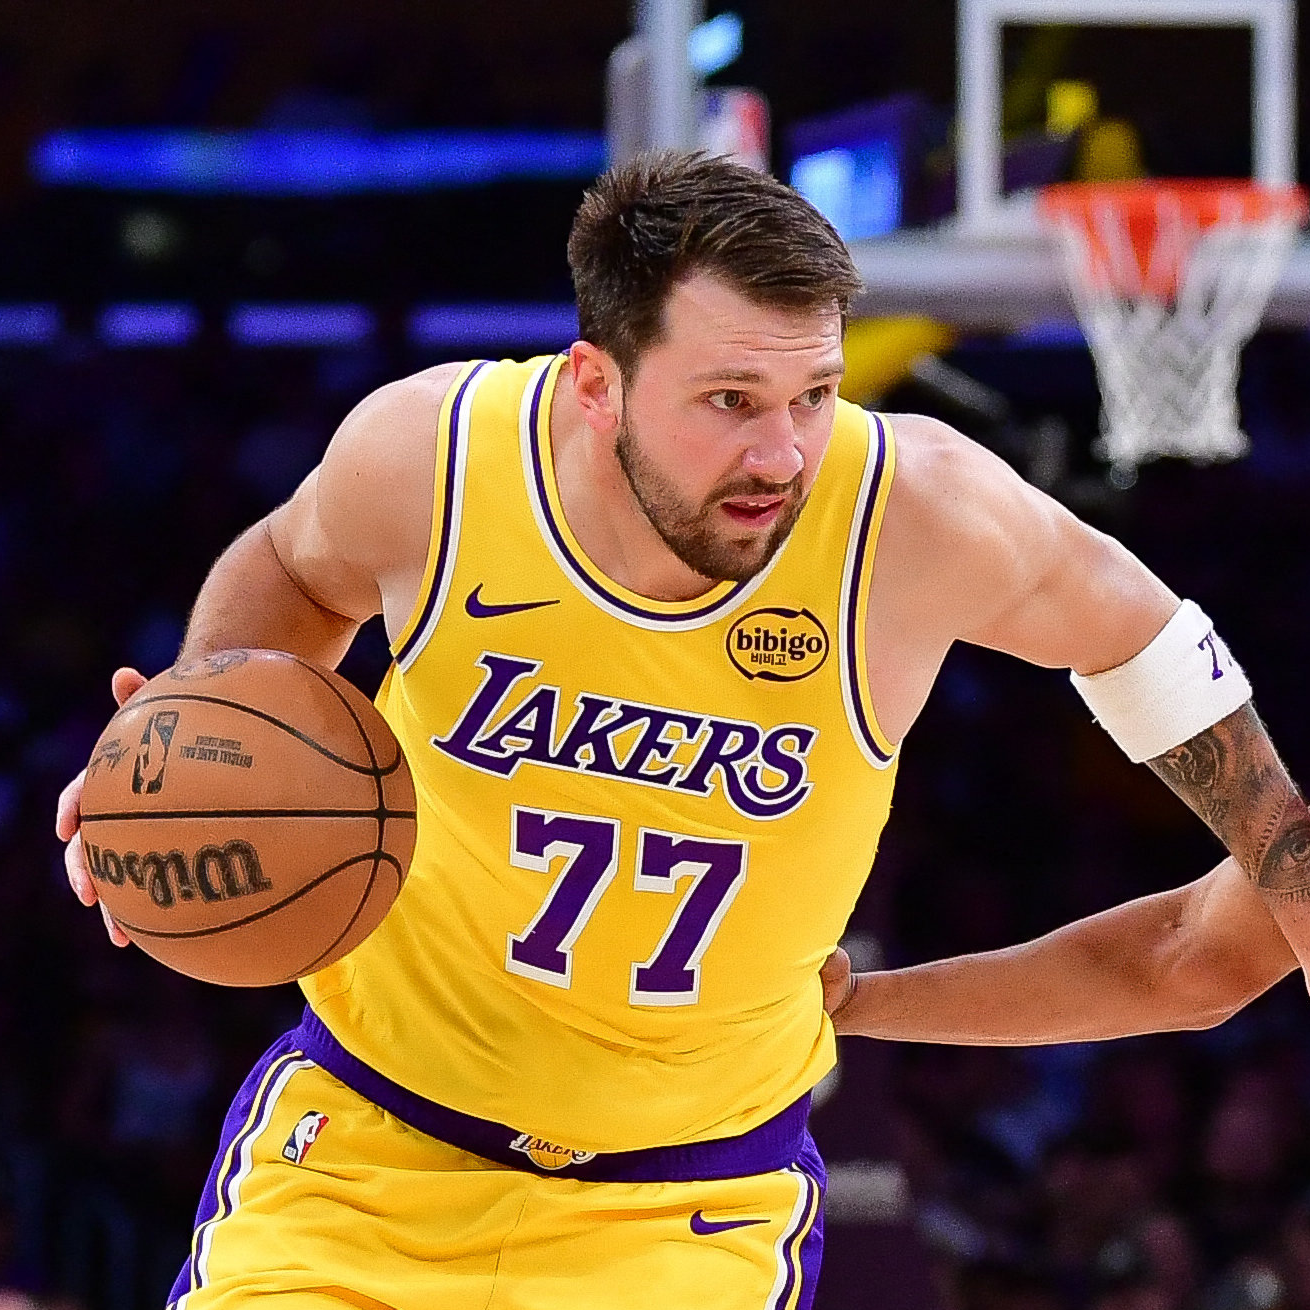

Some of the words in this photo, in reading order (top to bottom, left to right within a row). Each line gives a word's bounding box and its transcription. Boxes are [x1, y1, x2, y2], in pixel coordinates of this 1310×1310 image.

[736, 626, 823, 661] bibigo
[750, 652, 787, 666] 비비고
[432, 651, 818, 819] LAKERS
[84, 838, 273, 908] Wilson
[505, 803, 749, 1007] 77
